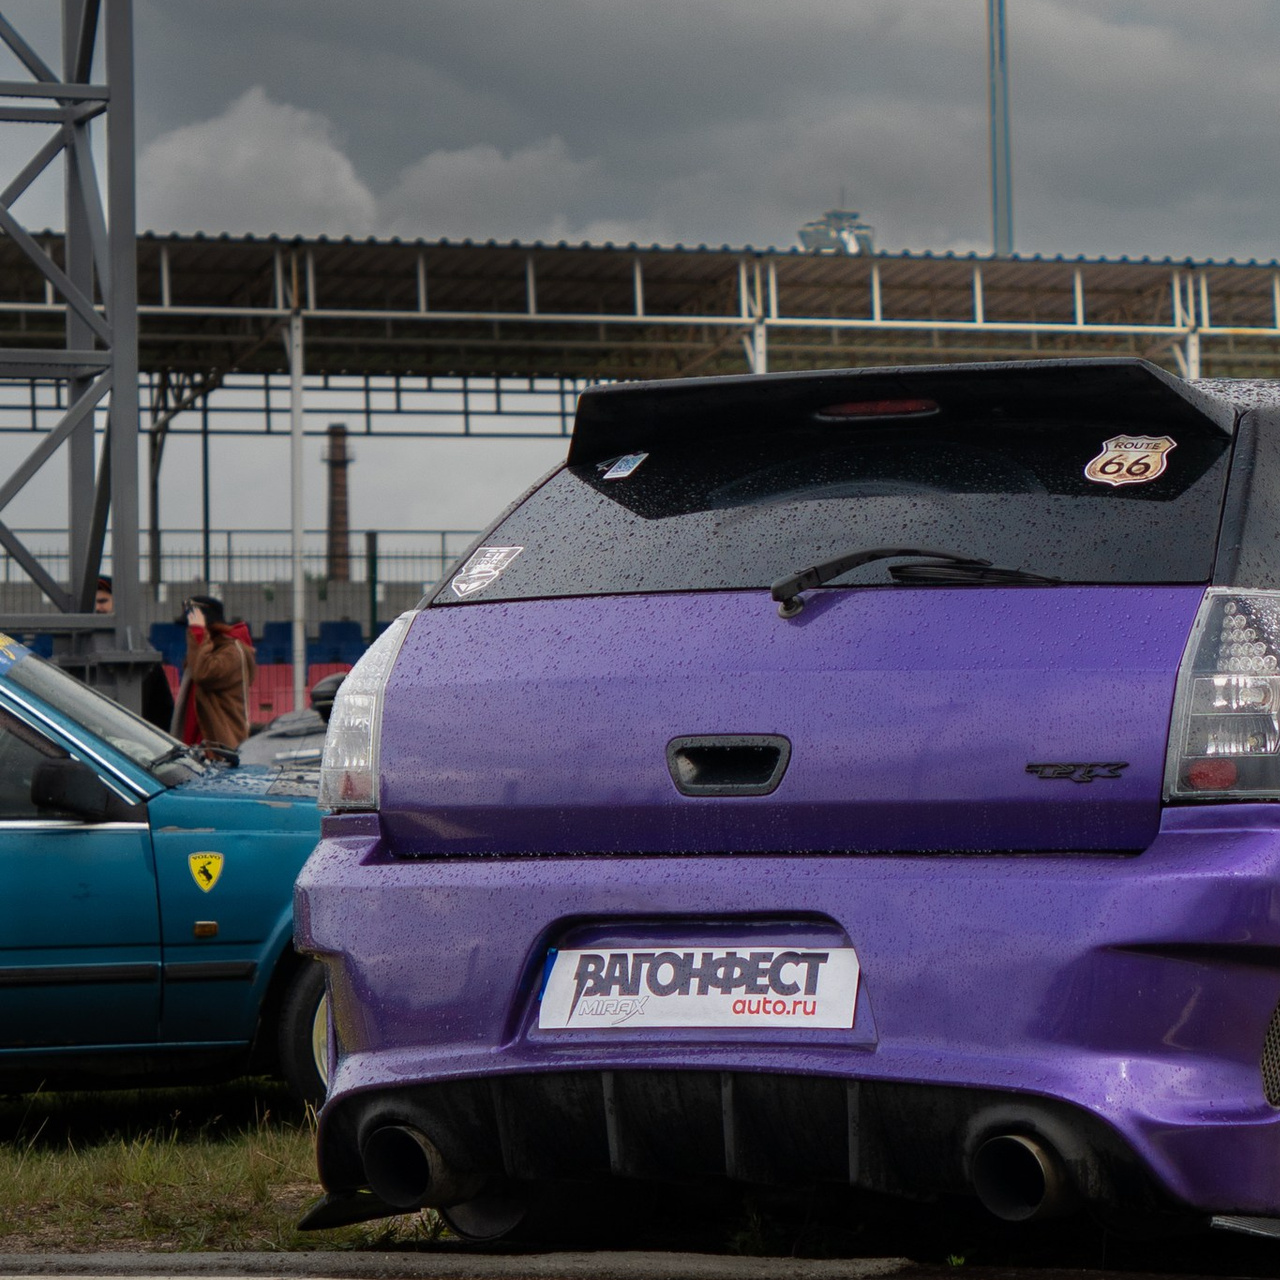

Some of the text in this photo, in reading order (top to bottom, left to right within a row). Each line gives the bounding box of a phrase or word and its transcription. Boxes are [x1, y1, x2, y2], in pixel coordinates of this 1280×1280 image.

[1113, 441, 1161, 450] ROUTE
[1099, 454, 1151, 476] 66
[566, 951, 829, 1026] ВАГОНФЕСТ
[578, 996, 650, 1025] MIRAX
[732, 998, 817, 1016] auto.ru
